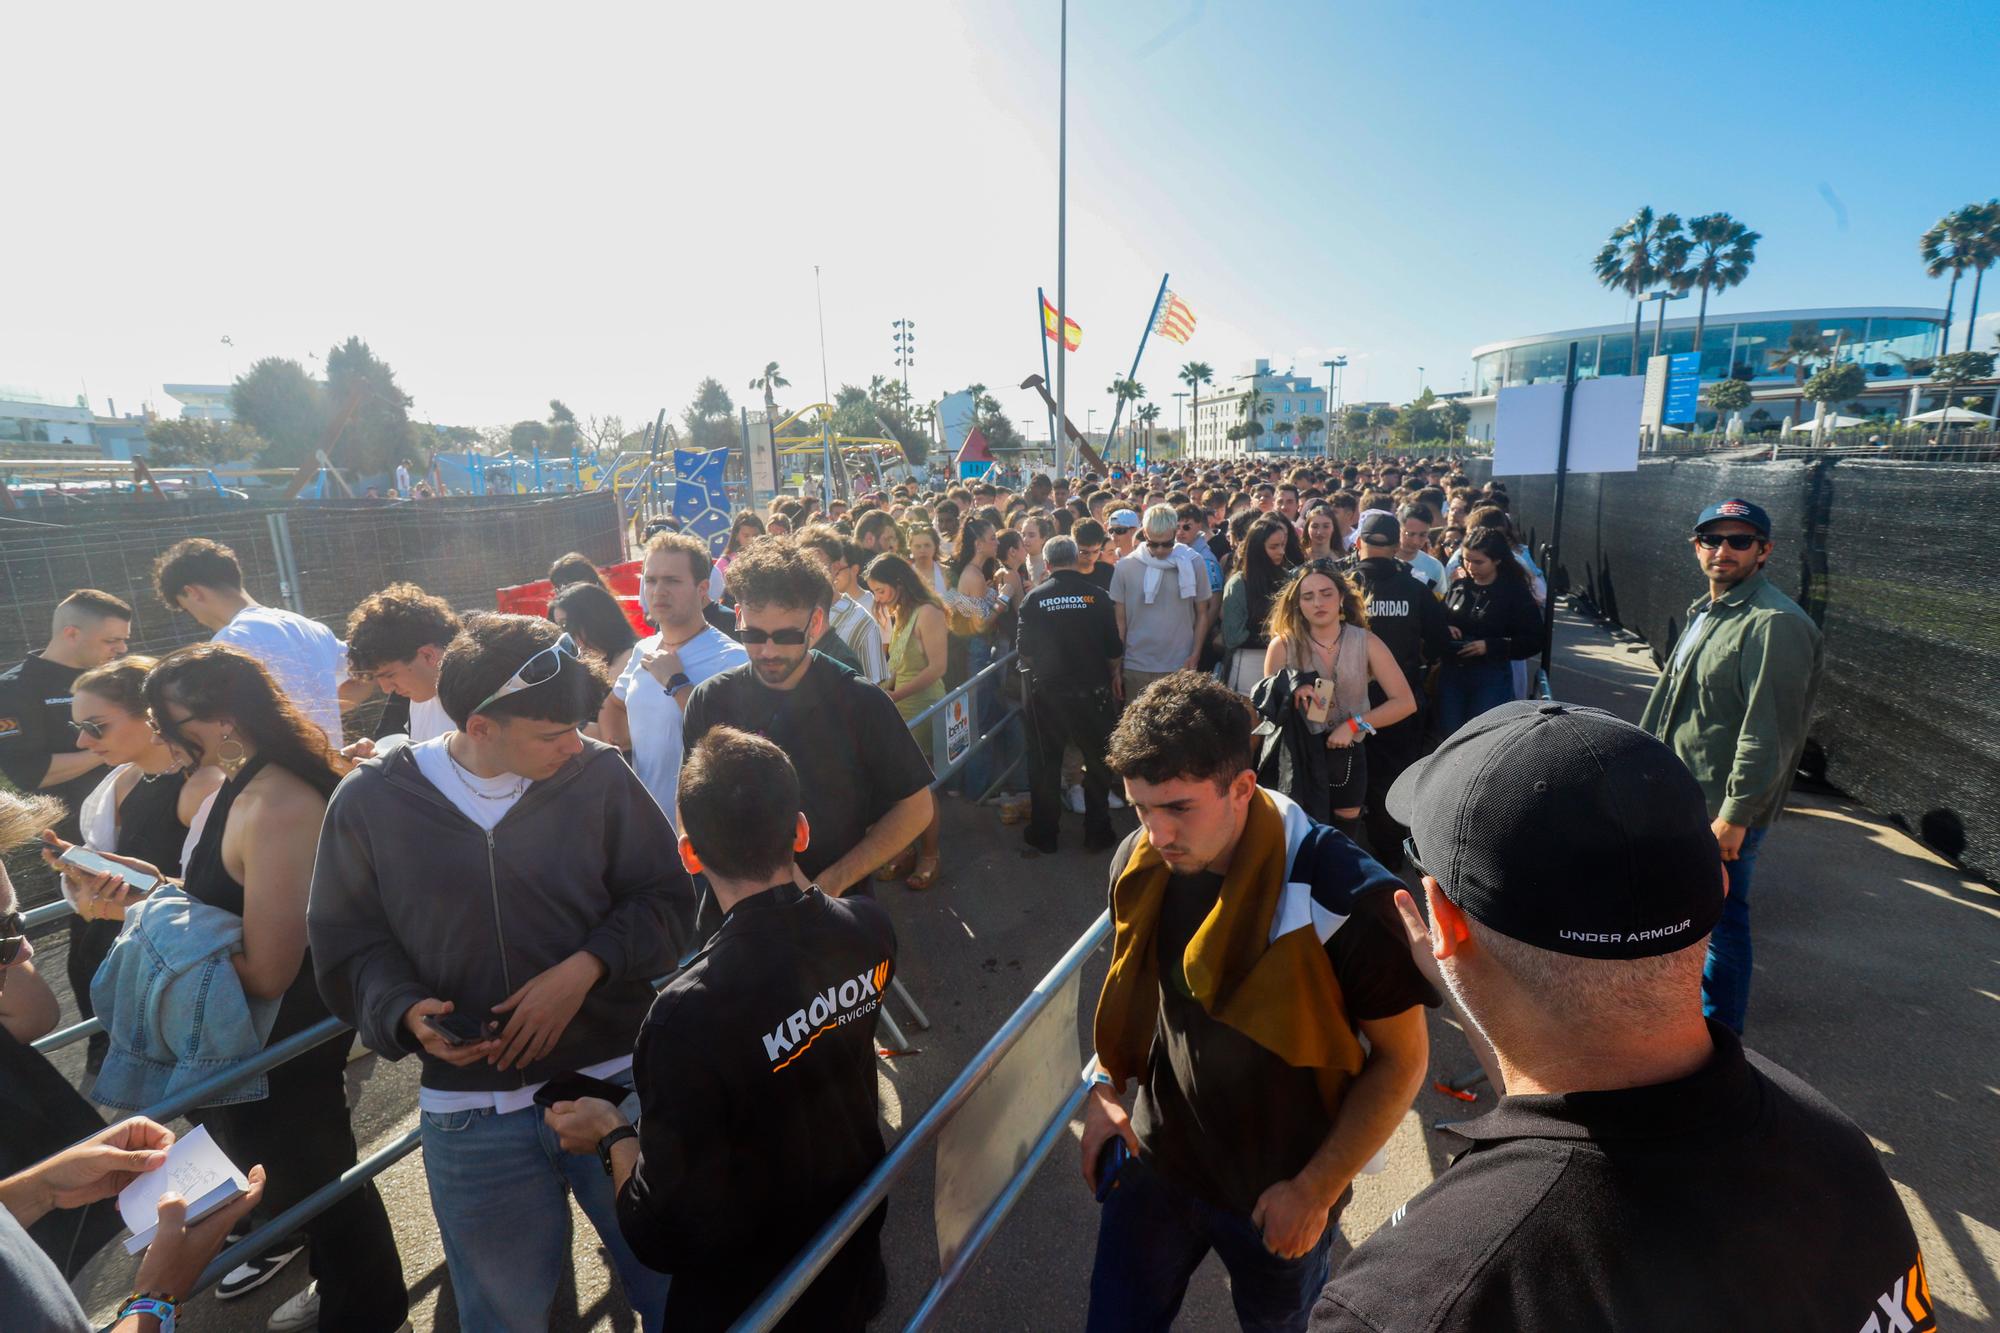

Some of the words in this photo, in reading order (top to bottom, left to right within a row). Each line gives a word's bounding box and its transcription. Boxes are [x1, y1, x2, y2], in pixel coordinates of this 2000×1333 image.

[1039, 595, 1084, 608] KRONOX
[1047, 603, 1088, 612] SEGURIDAD
[1365, 600, 1409, 617] GURIDAD
[1559, 929, 1622, 943] UNDER
[1626, 919, 1691, 943] ARMOUR
[762, 968, 876, 1062] KRONOX
[835, 999, 877, 1026] RVICIOS
